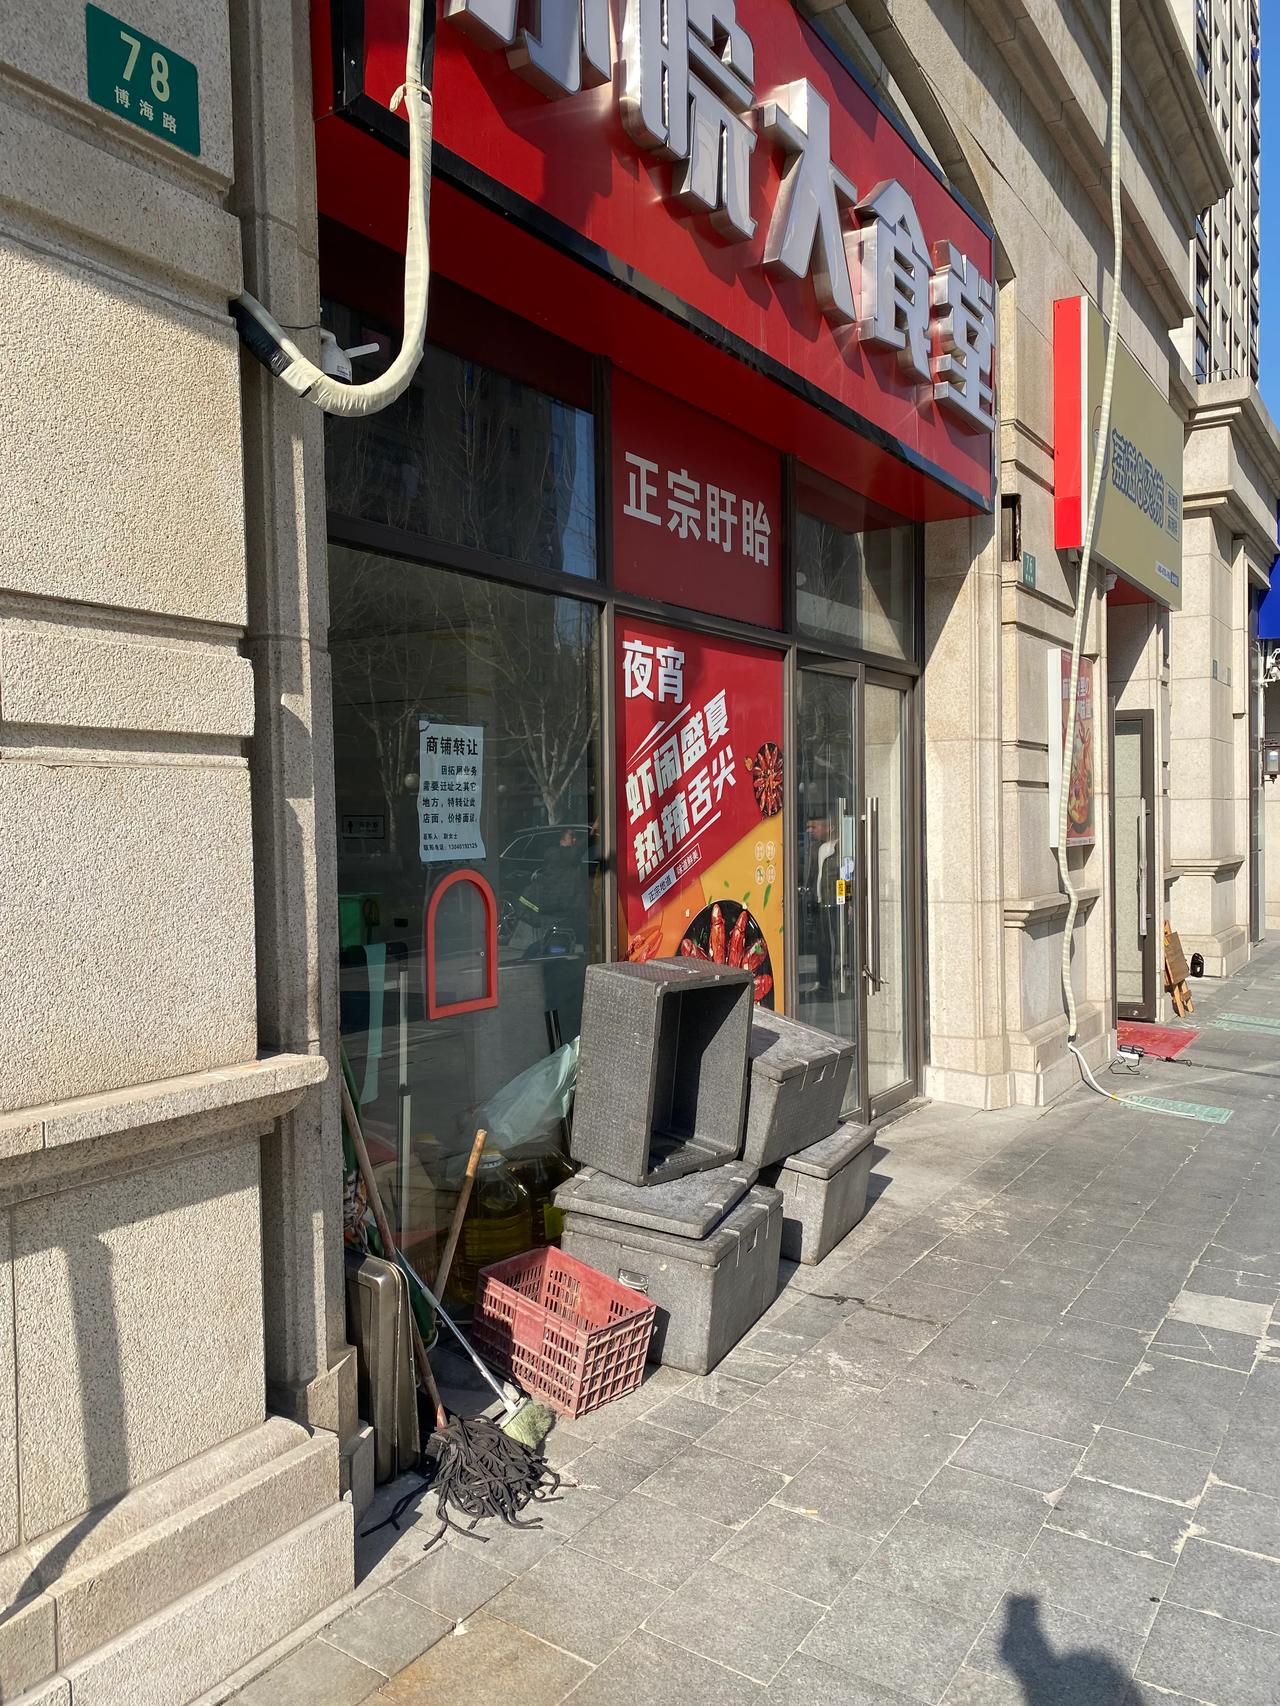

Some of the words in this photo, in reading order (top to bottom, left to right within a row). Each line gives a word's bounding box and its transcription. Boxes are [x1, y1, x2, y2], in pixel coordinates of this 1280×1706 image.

[120, 31, 170, 102] 78
[114, 85, 177, 134] 博海路
[624, 451, 771, 567] 正宗盱眙
[622, 639, 685, 704] 夜宵
[426, 736, 479, 757] 商铺转让
[625, 688, 730, 825] 虾闹盛夏
[633, 744, 738, 883] 热辣舌尖
[647, 874, 673, 903] 正宗地道
